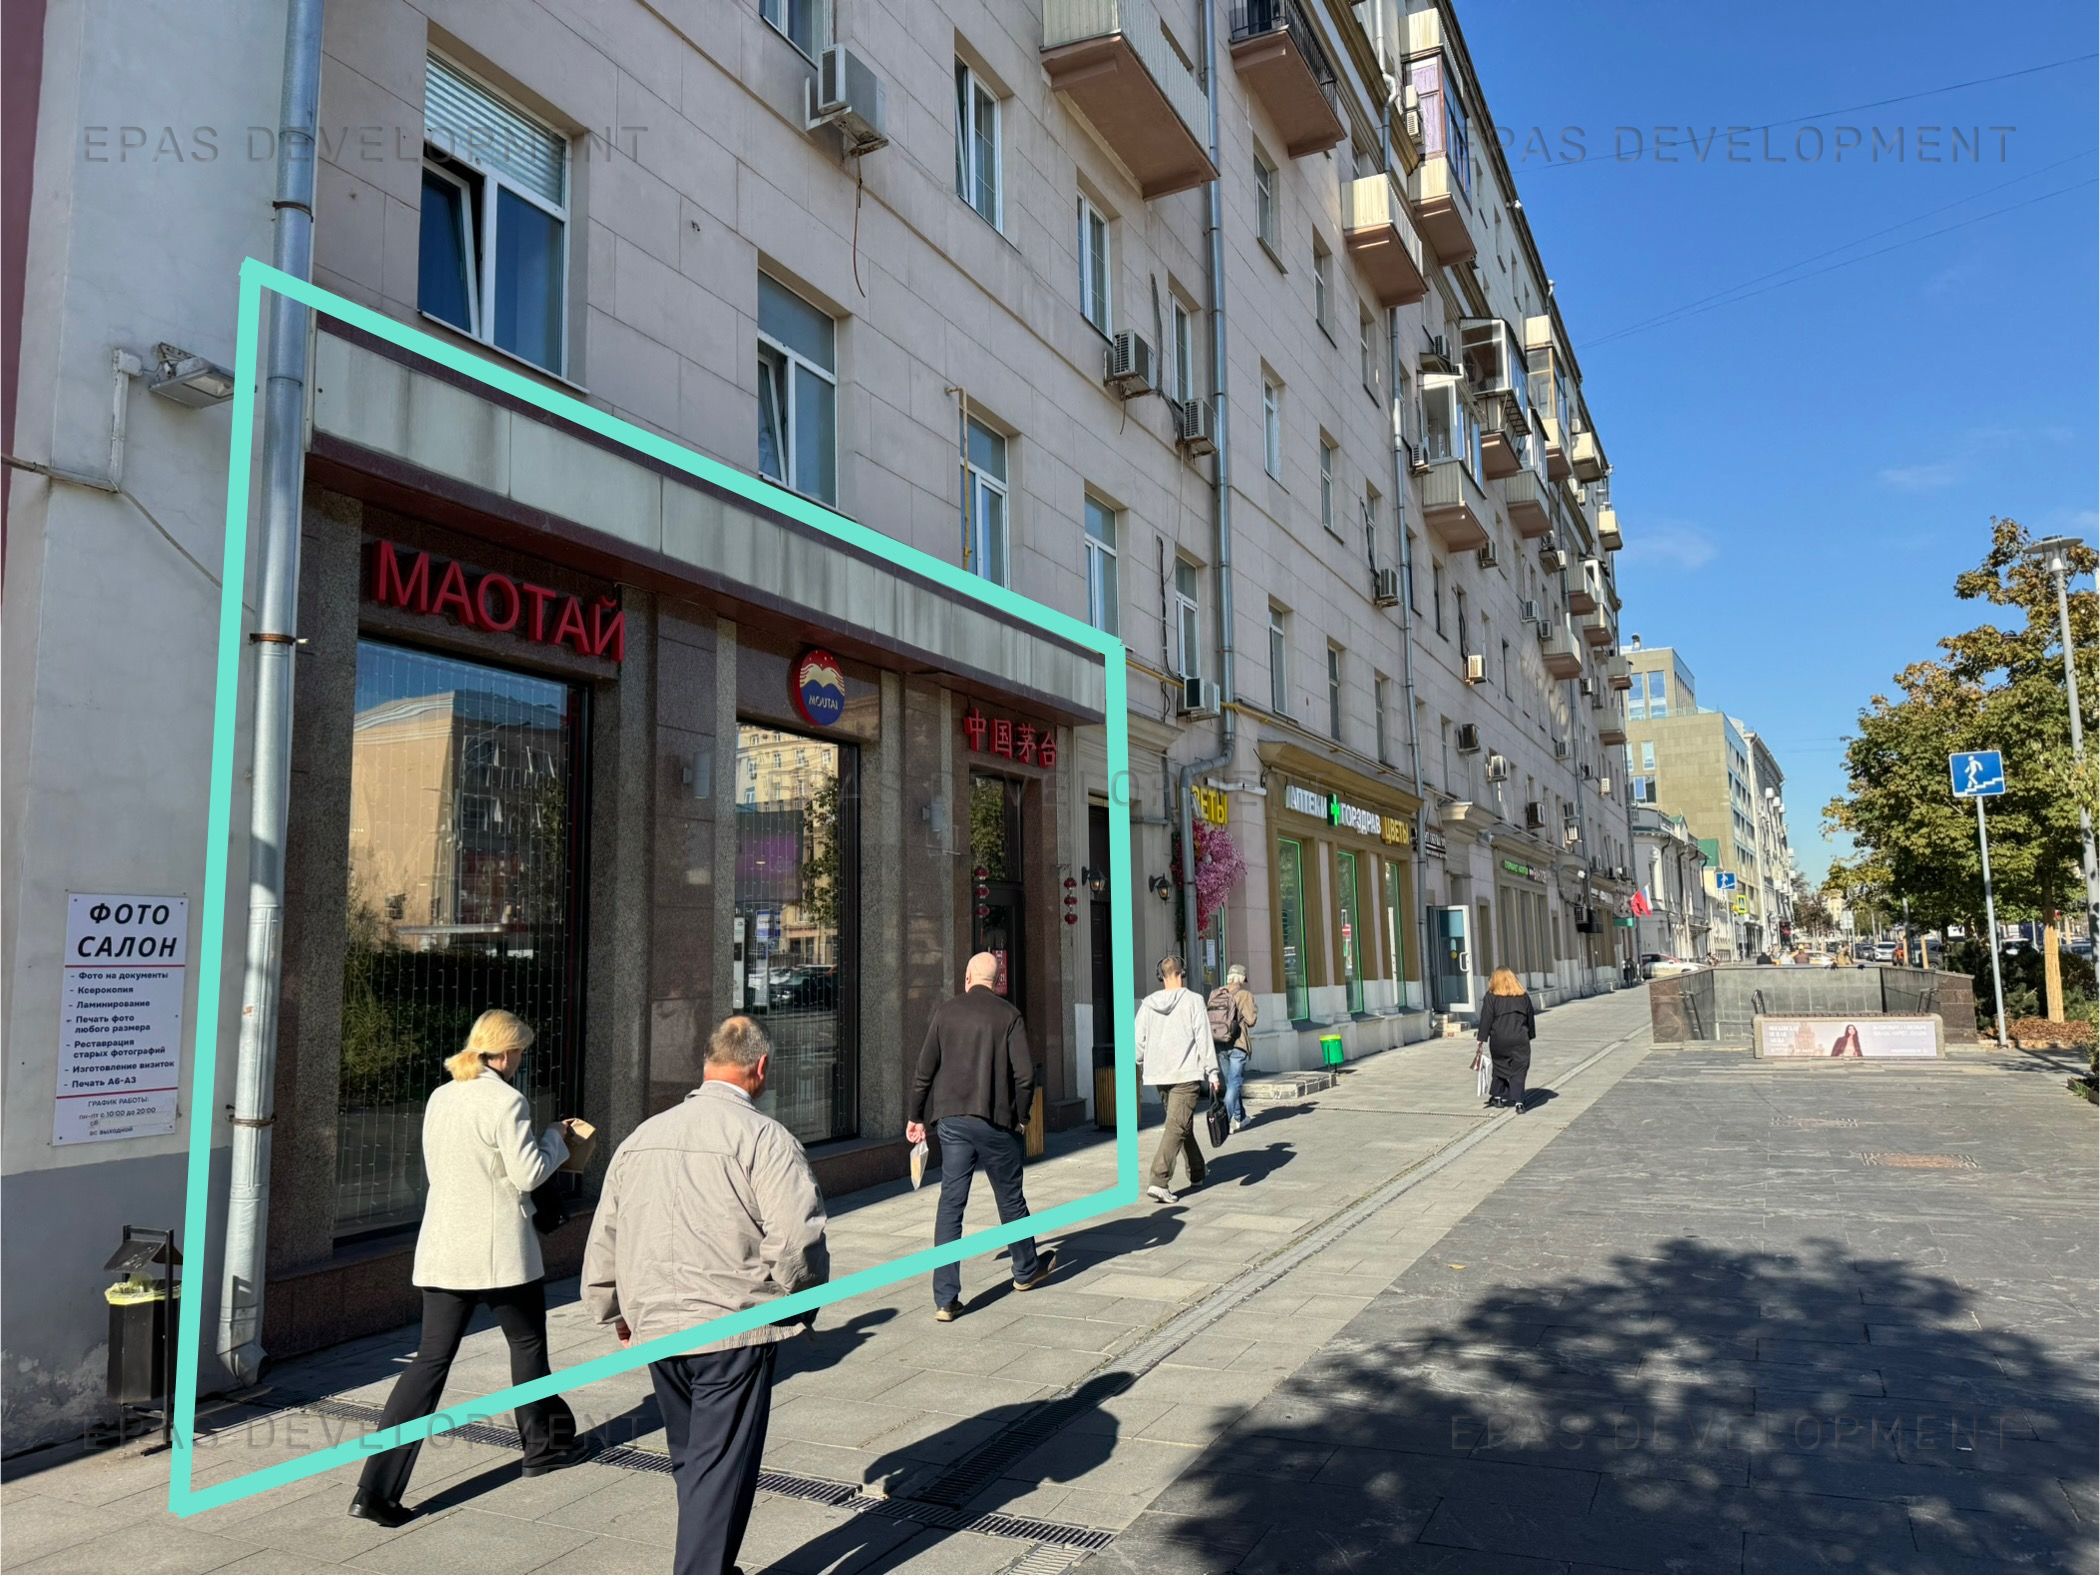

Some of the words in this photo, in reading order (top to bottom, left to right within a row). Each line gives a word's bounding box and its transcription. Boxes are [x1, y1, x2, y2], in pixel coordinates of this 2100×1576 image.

[373, 539, 625, 663] МАОТАЙ
[808, 694, 839, 711] MOUTAI
[964, 706, 1058, 769] 中国茅台
[1286, 785, 1328, 819] АПТЕКИ
[1339, 803, 1382, 835] ГОРЗДРАВ
[1381, 815, 1410, 846] ЦВЕТЫ
[89, 903, 170, 925] ФОТО
[77, 936, 177, 958] САЛОН
[119, 972, 168, 980] документы
[78, 986, 134, 994] Ксерокопия
[77, 1001, 150, 1009] Ламинирование
[112, 1025, 151, 1033] размера
[74, 1040, 135, 1048] Реставрация
[73, 1051, 108, 1059] старых
[111, 1046, 166, 1057] фотографий
[72, 1064, 138, 1073] Изготовление
[139, 1060, 175, 1069] визиток
[107, 1076, 137, 1085] А6-А3
[136, 1106, 156, 1114] 20:00
[99, 1126, 134, 1135] выходной
